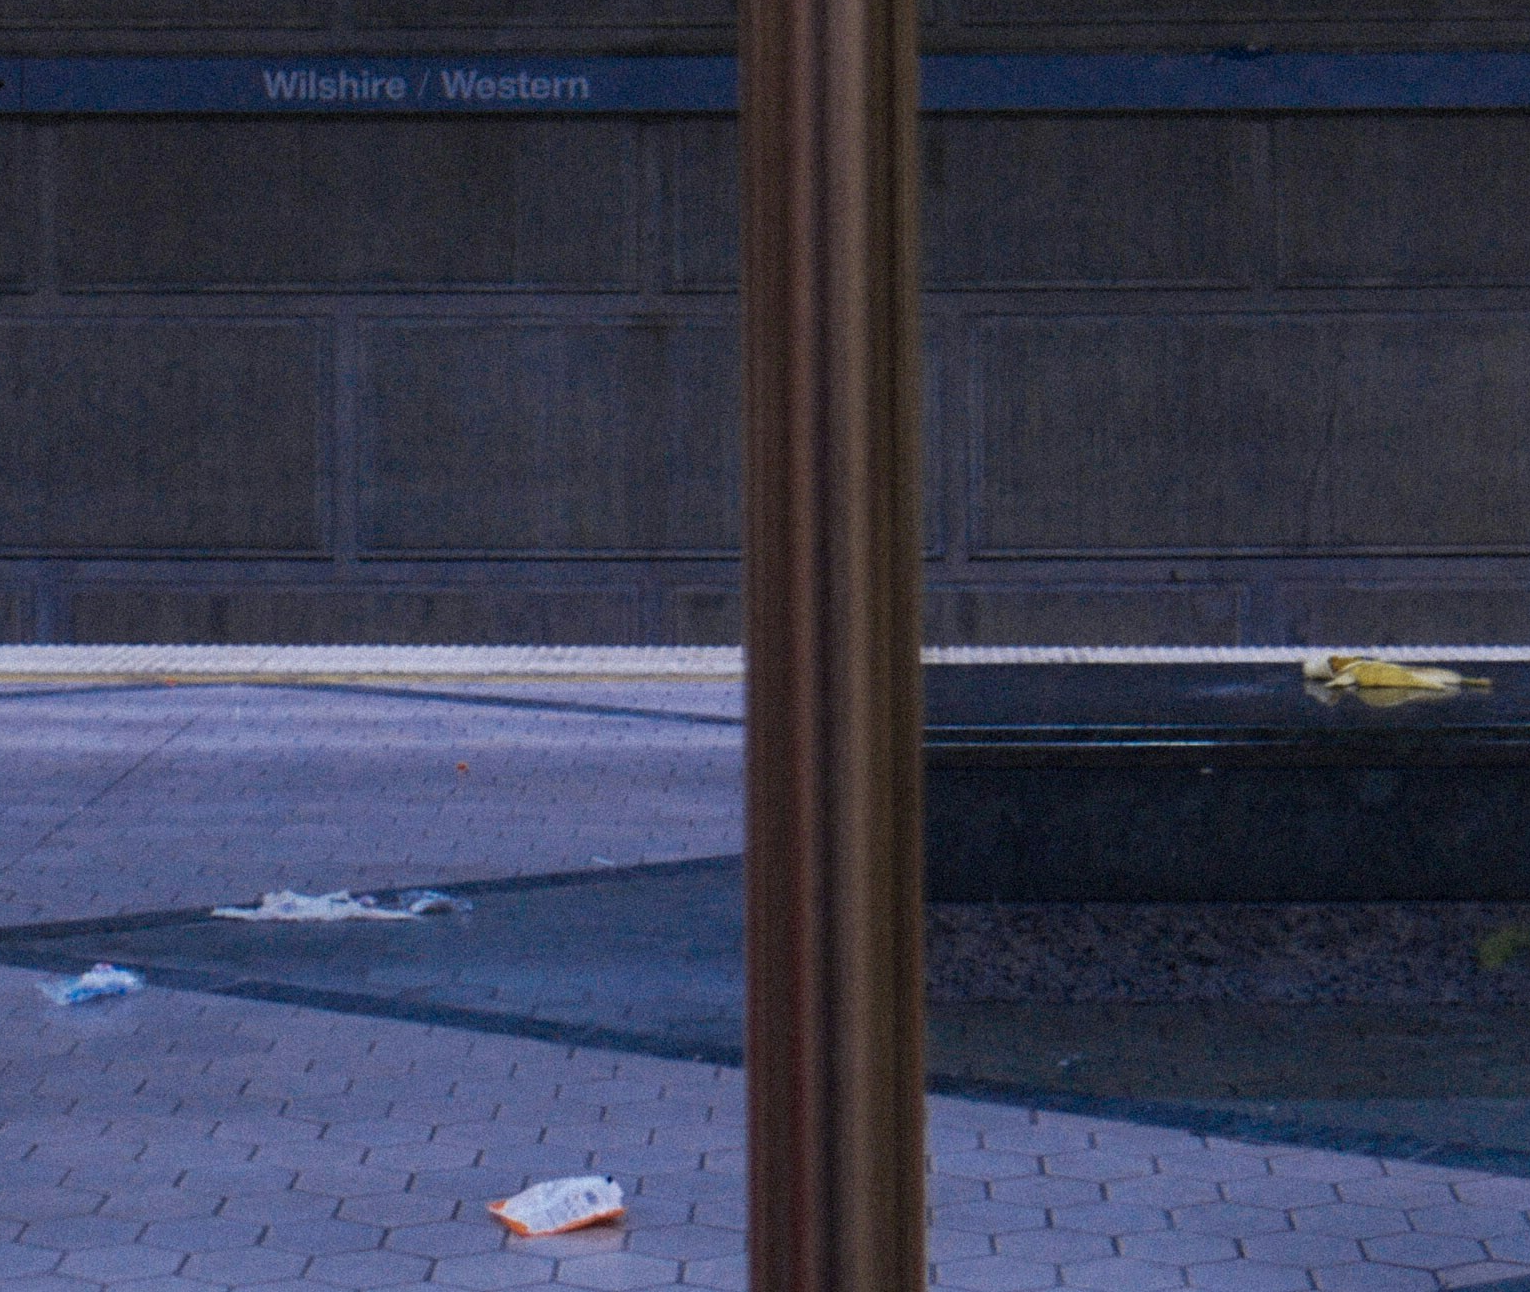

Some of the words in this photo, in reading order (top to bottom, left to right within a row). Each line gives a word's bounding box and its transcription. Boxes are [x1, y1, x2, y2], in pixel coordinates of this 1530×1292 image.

[262, 67, 406, 99] Wilshire
[416, 66, 431, 97] /
[440, 68, 589, 99] Western
